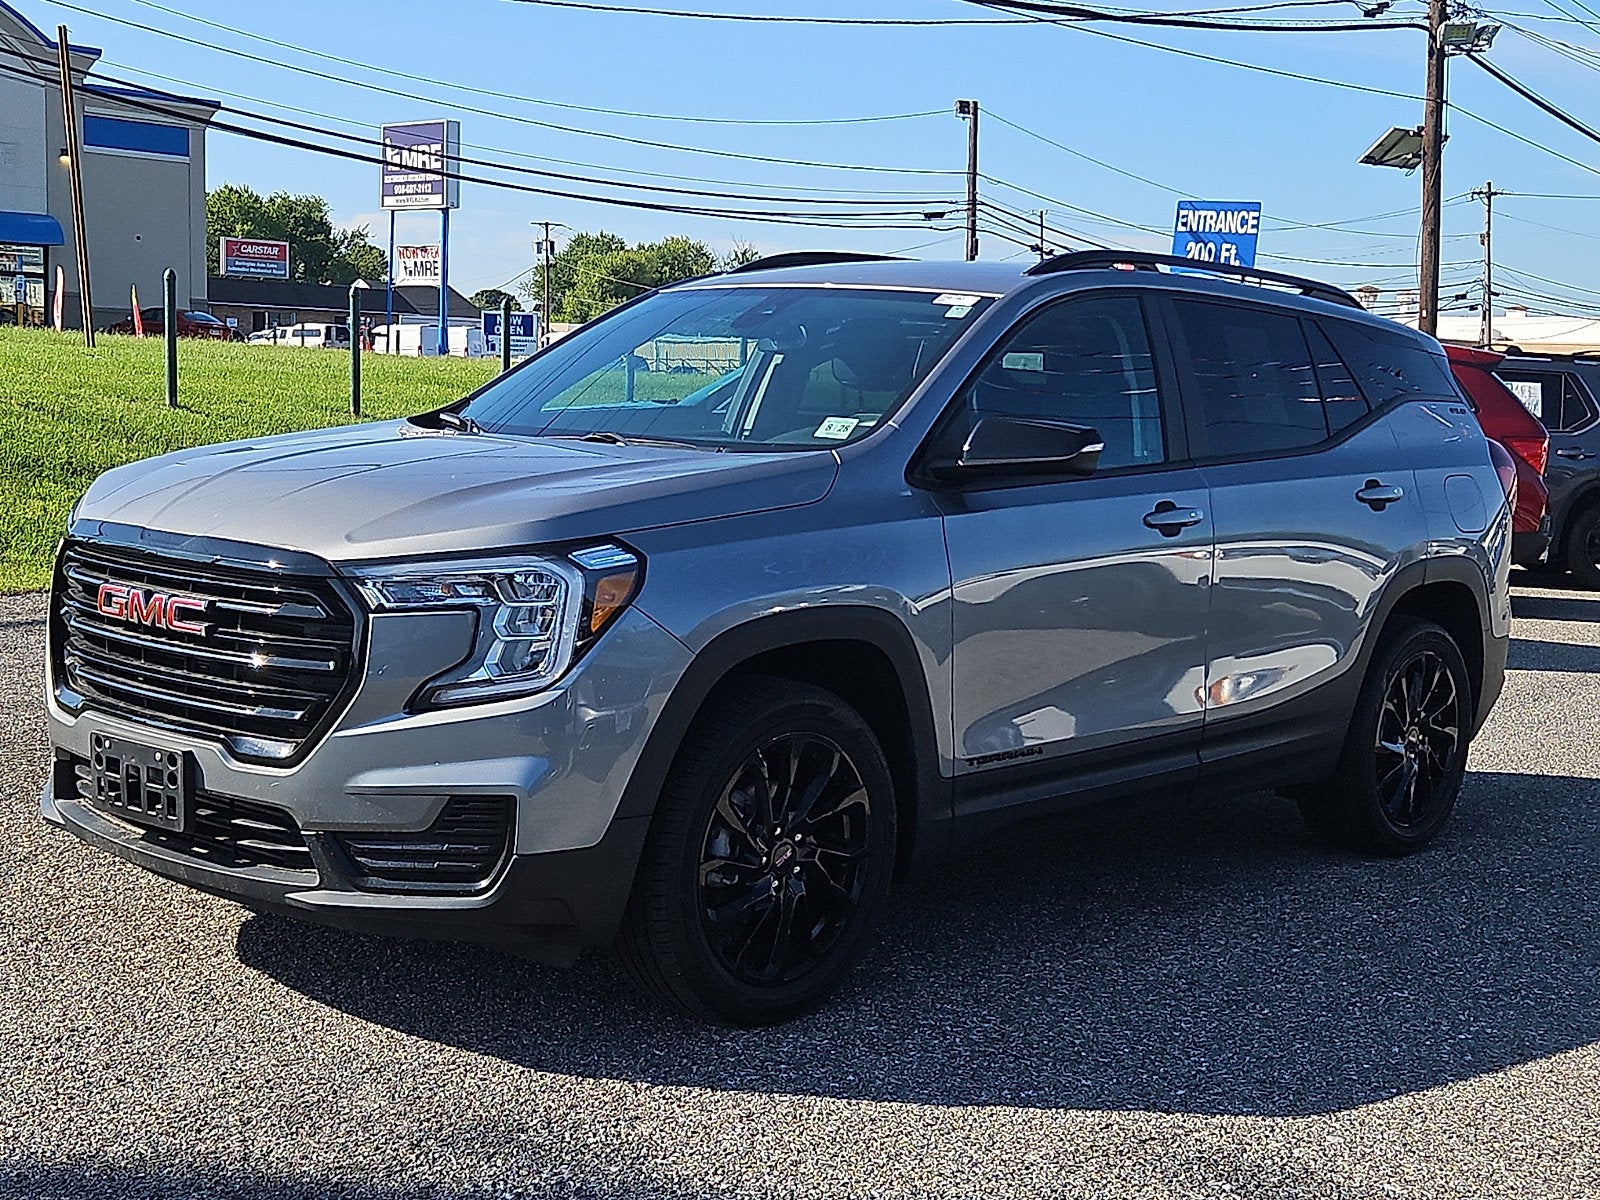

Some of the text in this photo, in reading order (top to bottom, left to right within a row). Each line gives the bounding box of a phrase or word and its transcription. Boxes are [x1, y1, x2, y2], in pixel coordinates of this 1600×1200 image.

[401, 143, 442, 170] MRE
[1177, 209, 1260, 234] ENTRANCE
[241, 244, 279, 255] CARSTAR
[398, 247, 439, 259] NOW OPEN
[1186, 241, 1241, 266] 200 Ft.
[413, 260, 439, 277] MRE
[497, 315, 522, 325] NW
[494, 325, 523, 335] OEN
[97, 583, 206, 637] GMC
[965, 746, 1043, 766] TERRAIN
